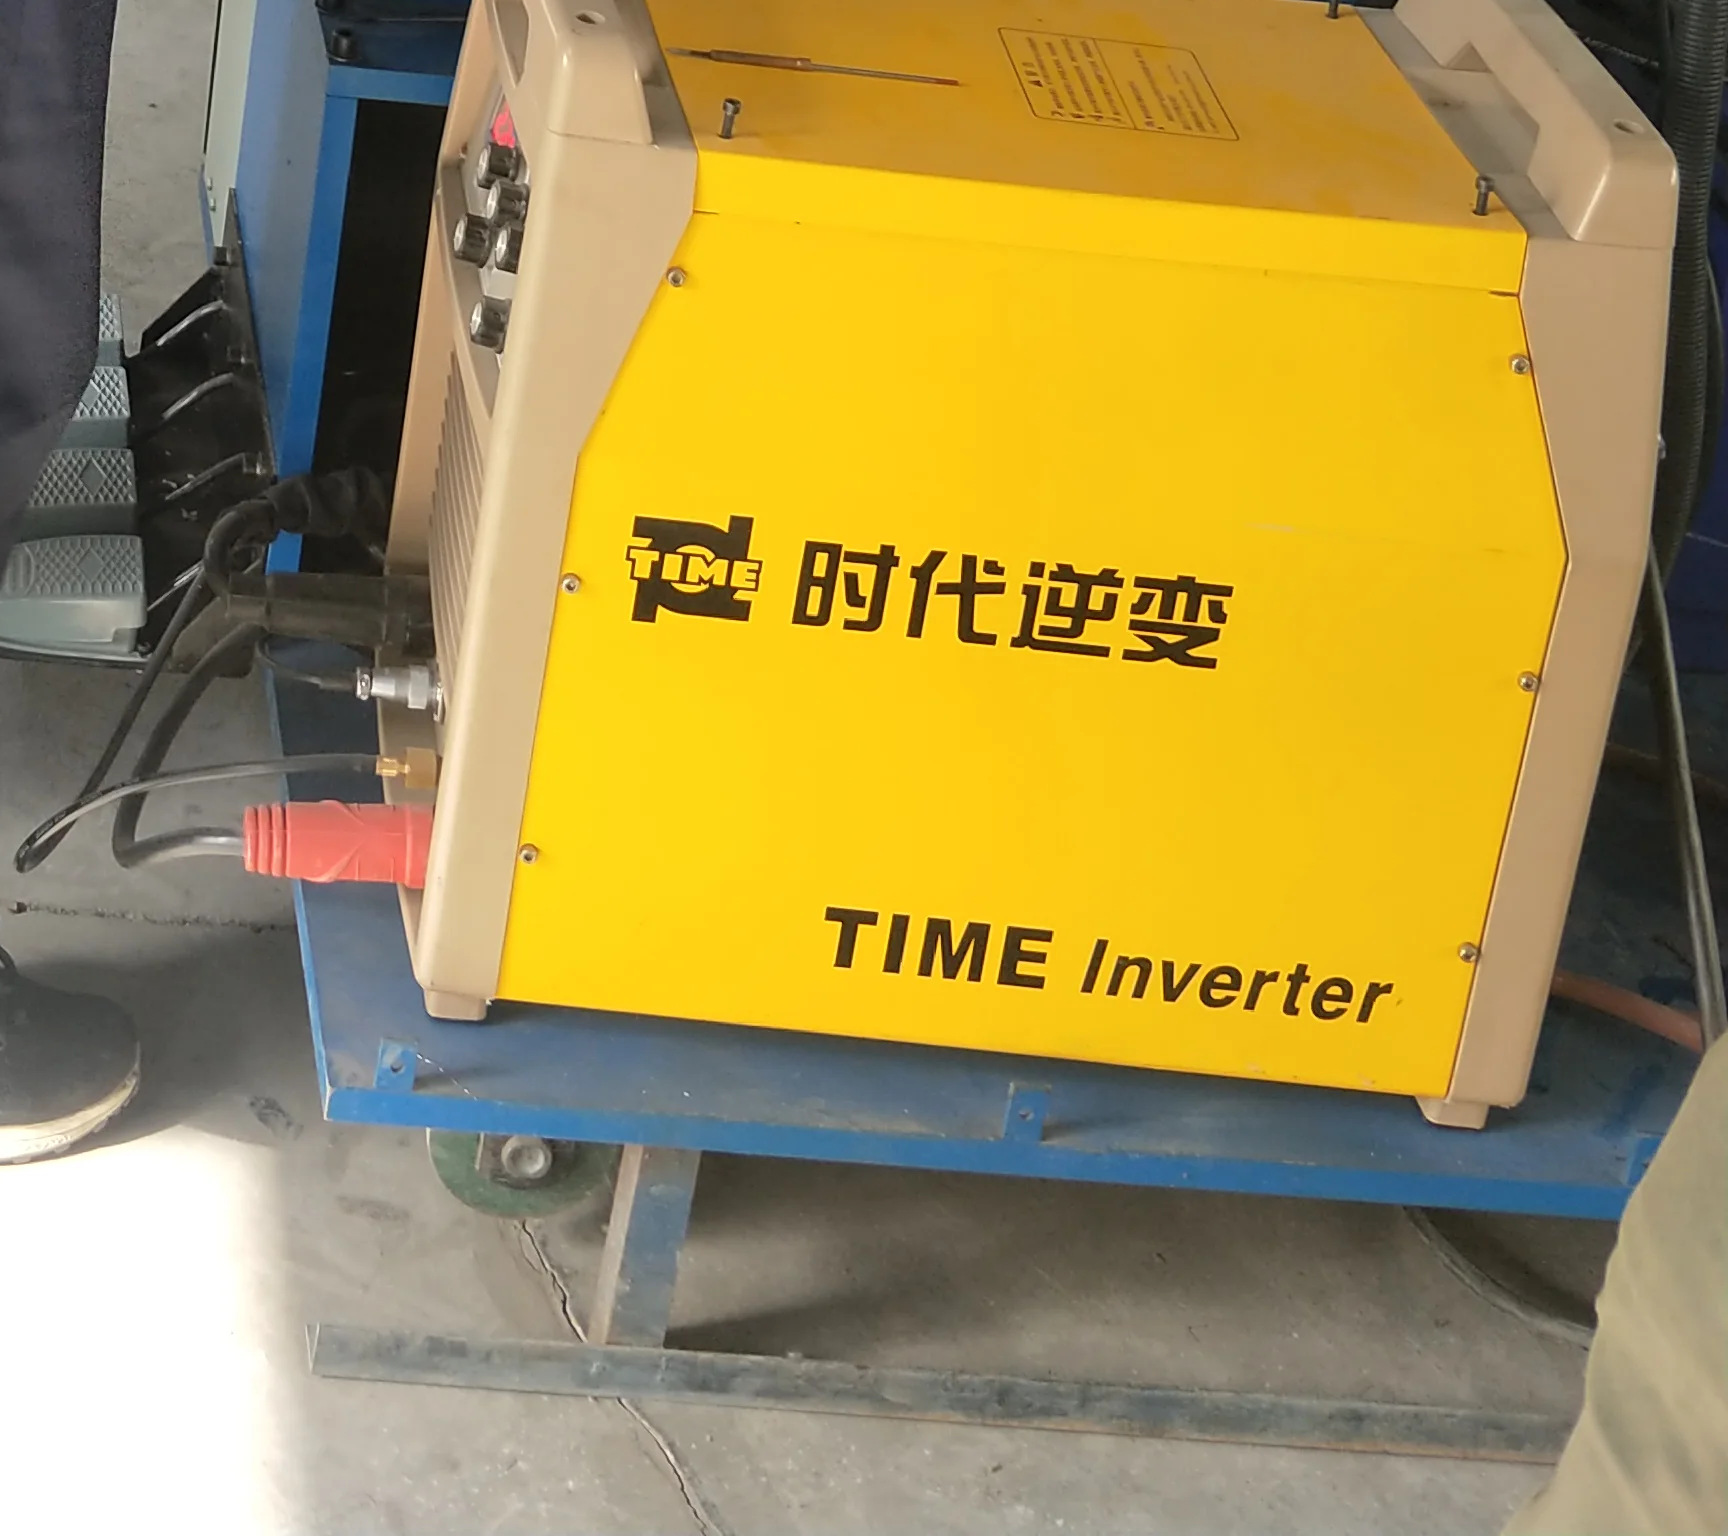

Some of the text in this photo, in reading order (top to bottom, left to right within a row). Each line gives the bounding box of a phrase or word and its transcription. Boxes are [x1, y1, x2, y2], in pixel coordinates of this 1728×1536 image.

[627, 545, 762, 592] TIME
[791, 540, 1234, 669] 时代逆变
[824, 906, 1393, 1024] TIME Inverter
